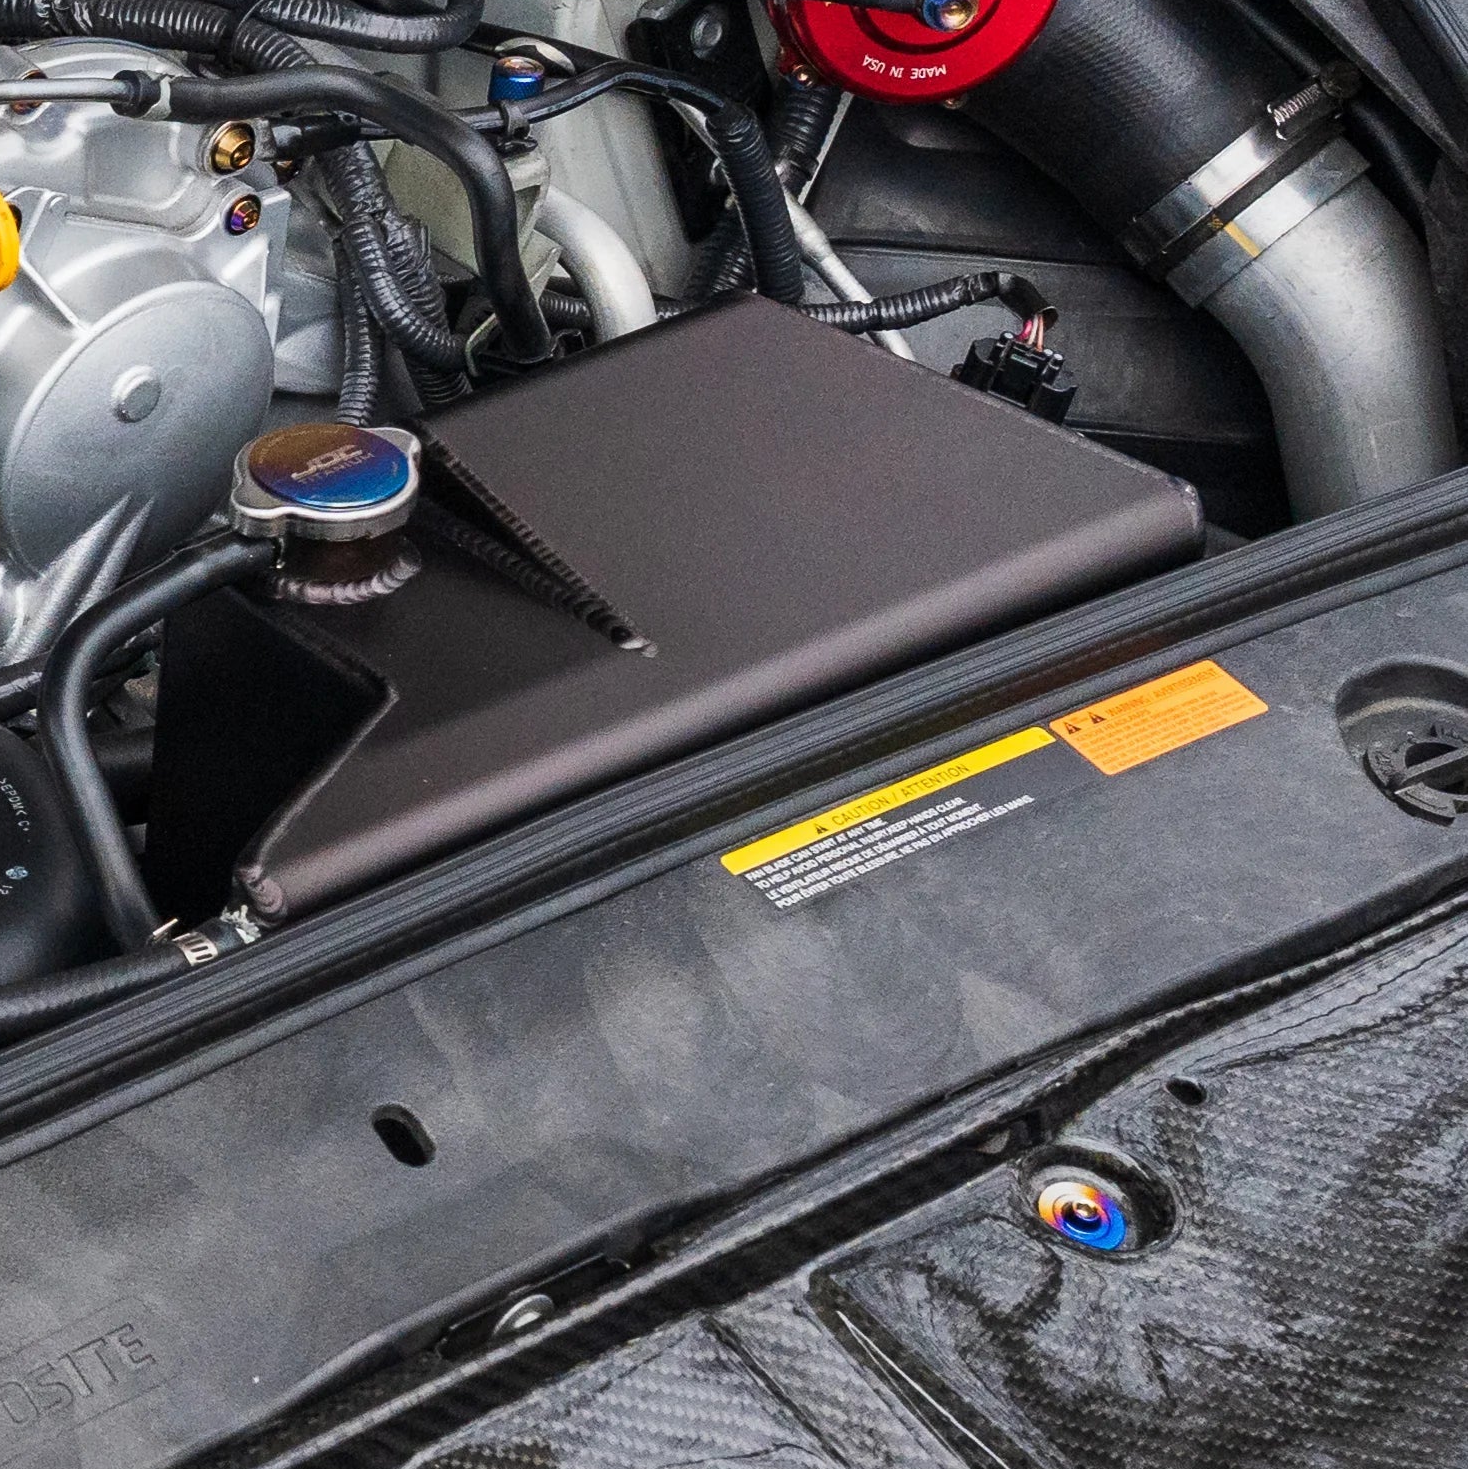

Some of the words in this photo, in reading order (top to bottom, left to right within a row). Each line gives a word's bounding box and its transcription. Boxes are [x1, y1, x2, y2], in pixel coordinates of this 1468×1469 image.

[862, 53, 886, 73] USA
[889, 64, 904, 78] IN
[910, 64, 947, 80] MADE
[831, 796, 891, 826] CAUTION
[901, 763, 971, 798] ATTENTION
[744, 870, 766, 882] FAN
[764, 857, 793, 873] BLADE
[790, 850, 813, 864] CAN
[808, 837, 839, 855] START
[835, 832, 849, 844] AT
[846, 825, 866, 839] ANY
[753, 879, 771, 890] TO
[767, 869, 792, 885] HELP
[790, 859, 819, 876] AVOID
[815, 841, 863, 864] PERSONAL
[906, 807, 940, 826] HANDS
[765, 889, 782, 901] LE
[776, 866, 834, 895] VENTILATEUR
[830, 854, 863, 872] RISQUE
[861, 848, 877, 860] DE
[923, 816, 950, 831] TOUT
[774, 892, 803, 910] POUR
[828, 868, 860, 885] TOUTE
[899, 843, 916, 856] NE
[911, 837, 932, 850] PAS
[941, 811, 993, 839] APPROCHER
[988, 804, 1009, 818] LES
